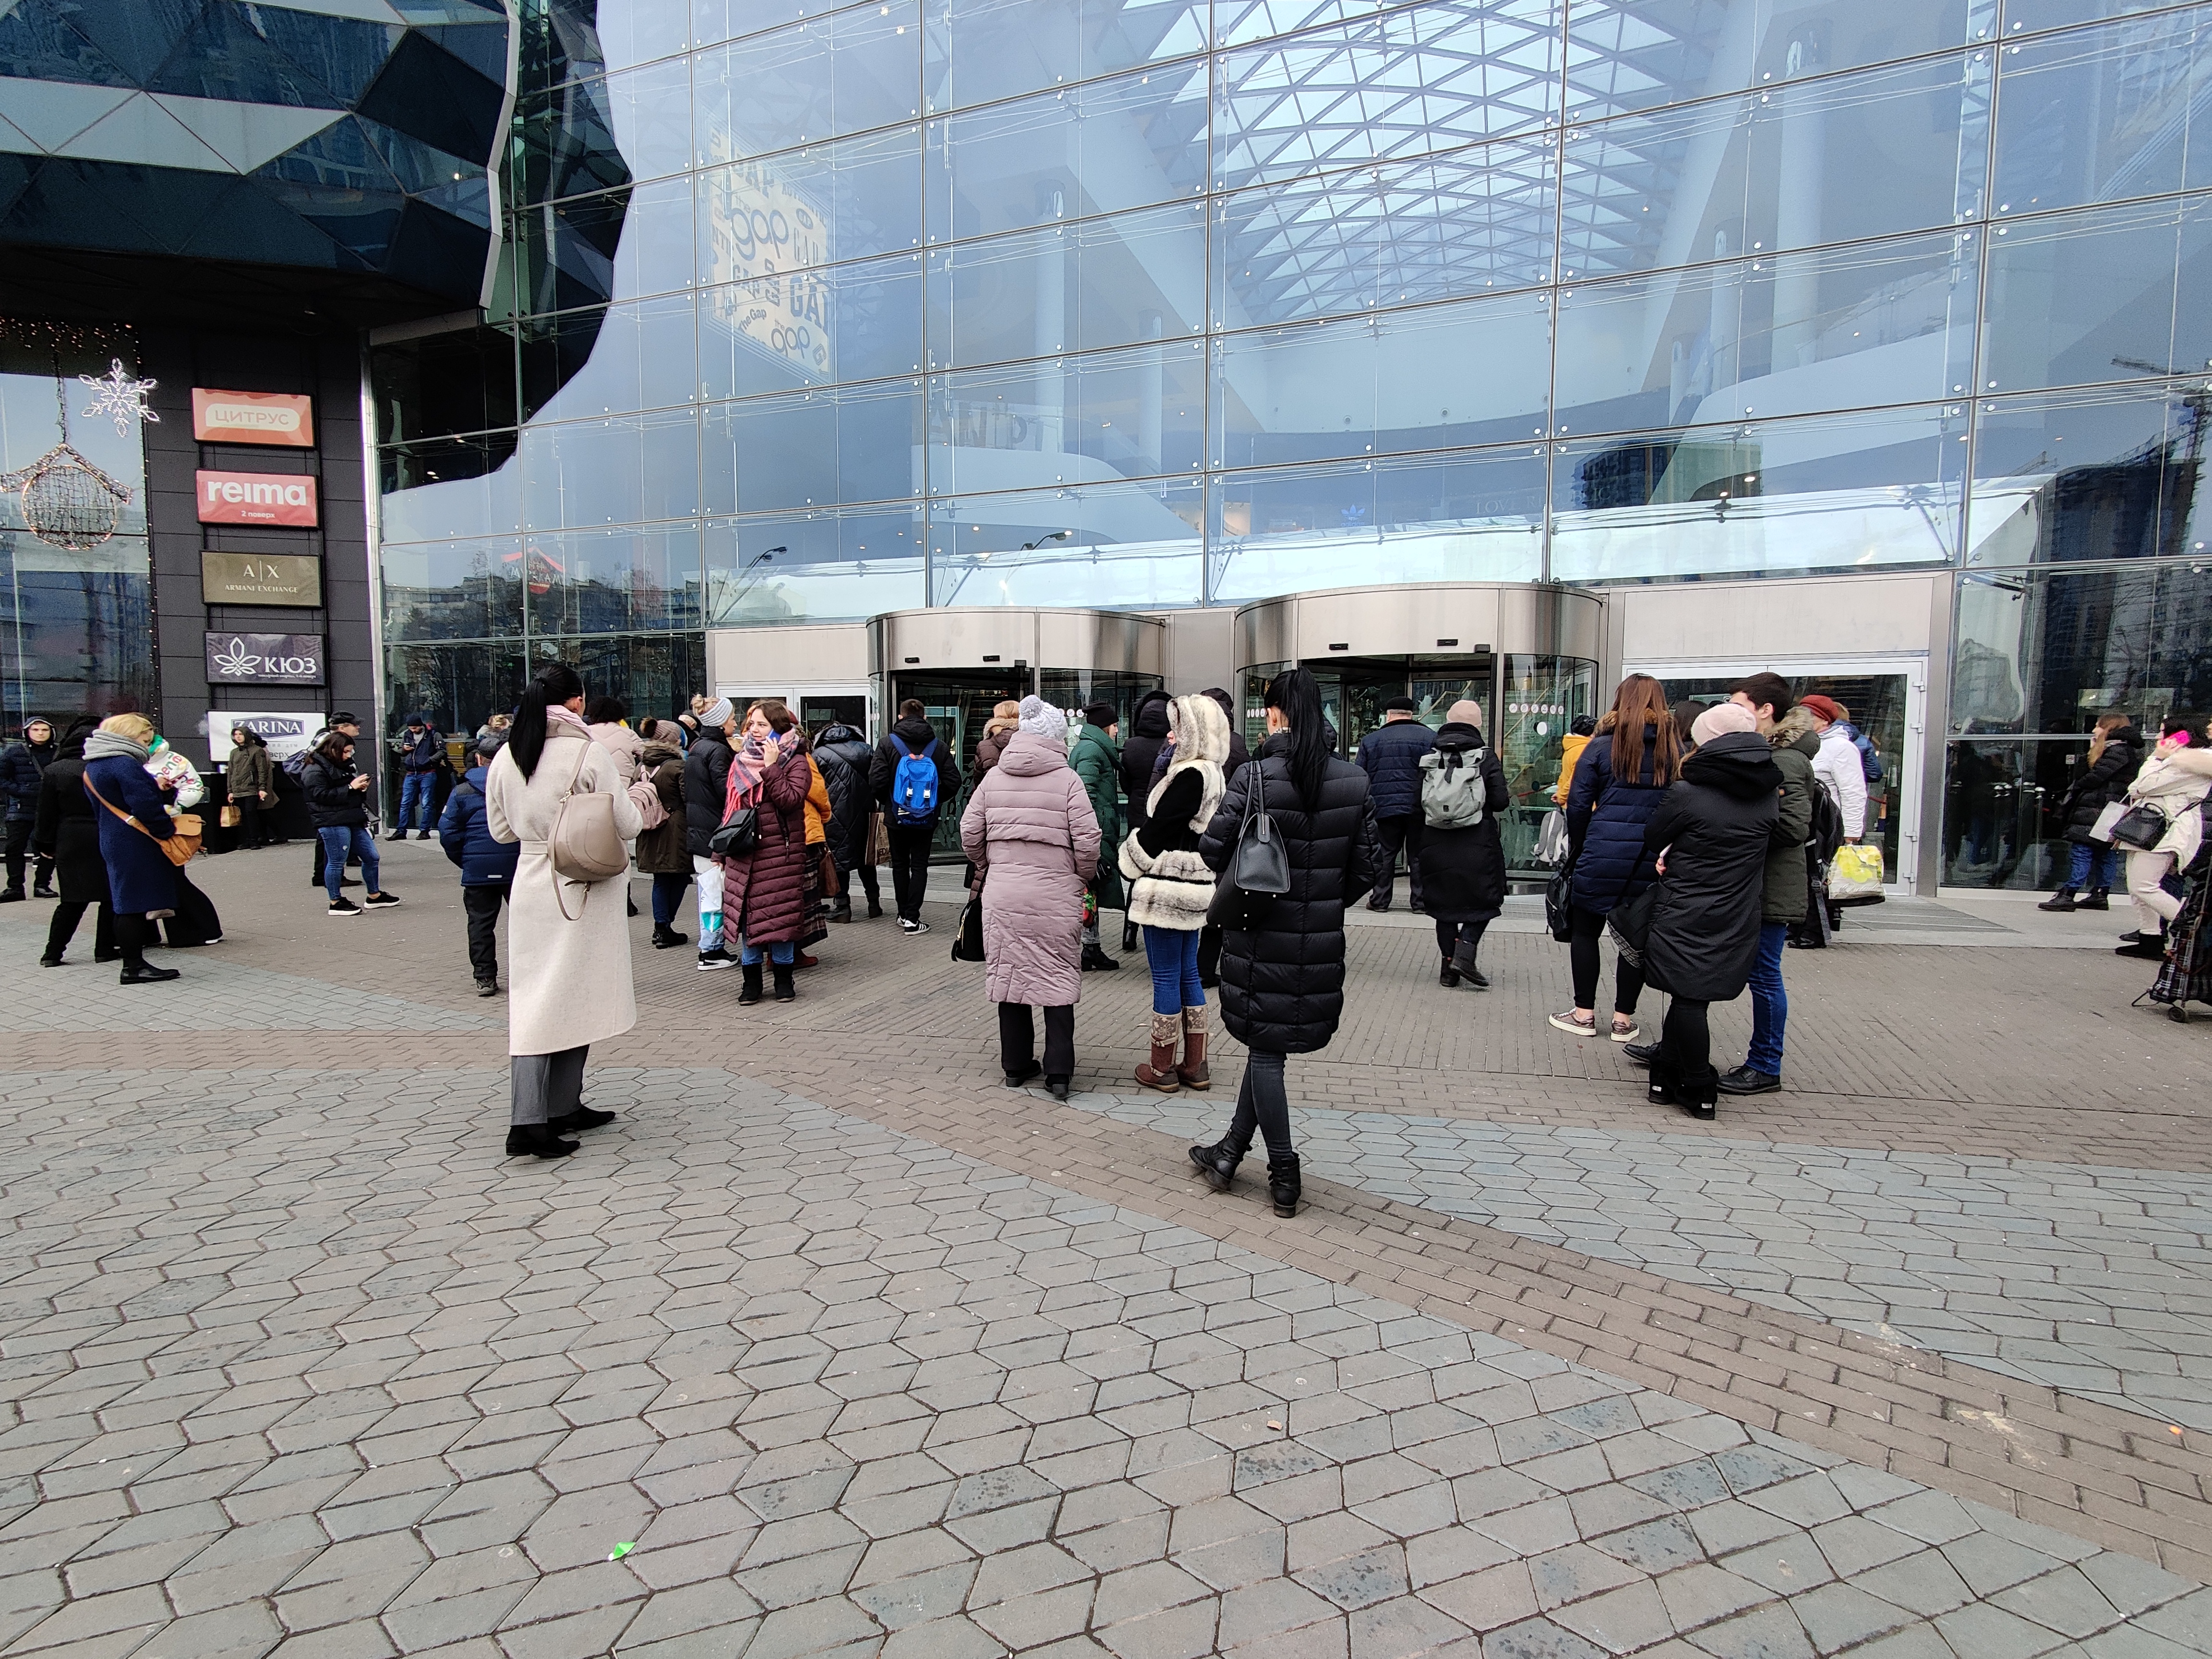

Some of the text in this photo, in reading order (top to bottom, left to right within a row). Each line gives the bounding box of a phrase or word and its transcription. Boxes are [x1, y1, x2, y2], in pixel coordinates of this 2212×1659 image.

[734, 193, 751, 214] the
[731, 207, 789, 261] gap
[749, 308, 767, 320] Gap
[774, 318, 785, 331] the
[771, 325, 810, 359] gap
[215, 410, 289, 425] ЦИТРУС
[207, 481, 307, 506] reima
[225, 584, 299, 593] ARMANI EXCHANGE
[265, 657, 317, 674] КЮЗ
[234, 721, 303, 734] ZARINA
